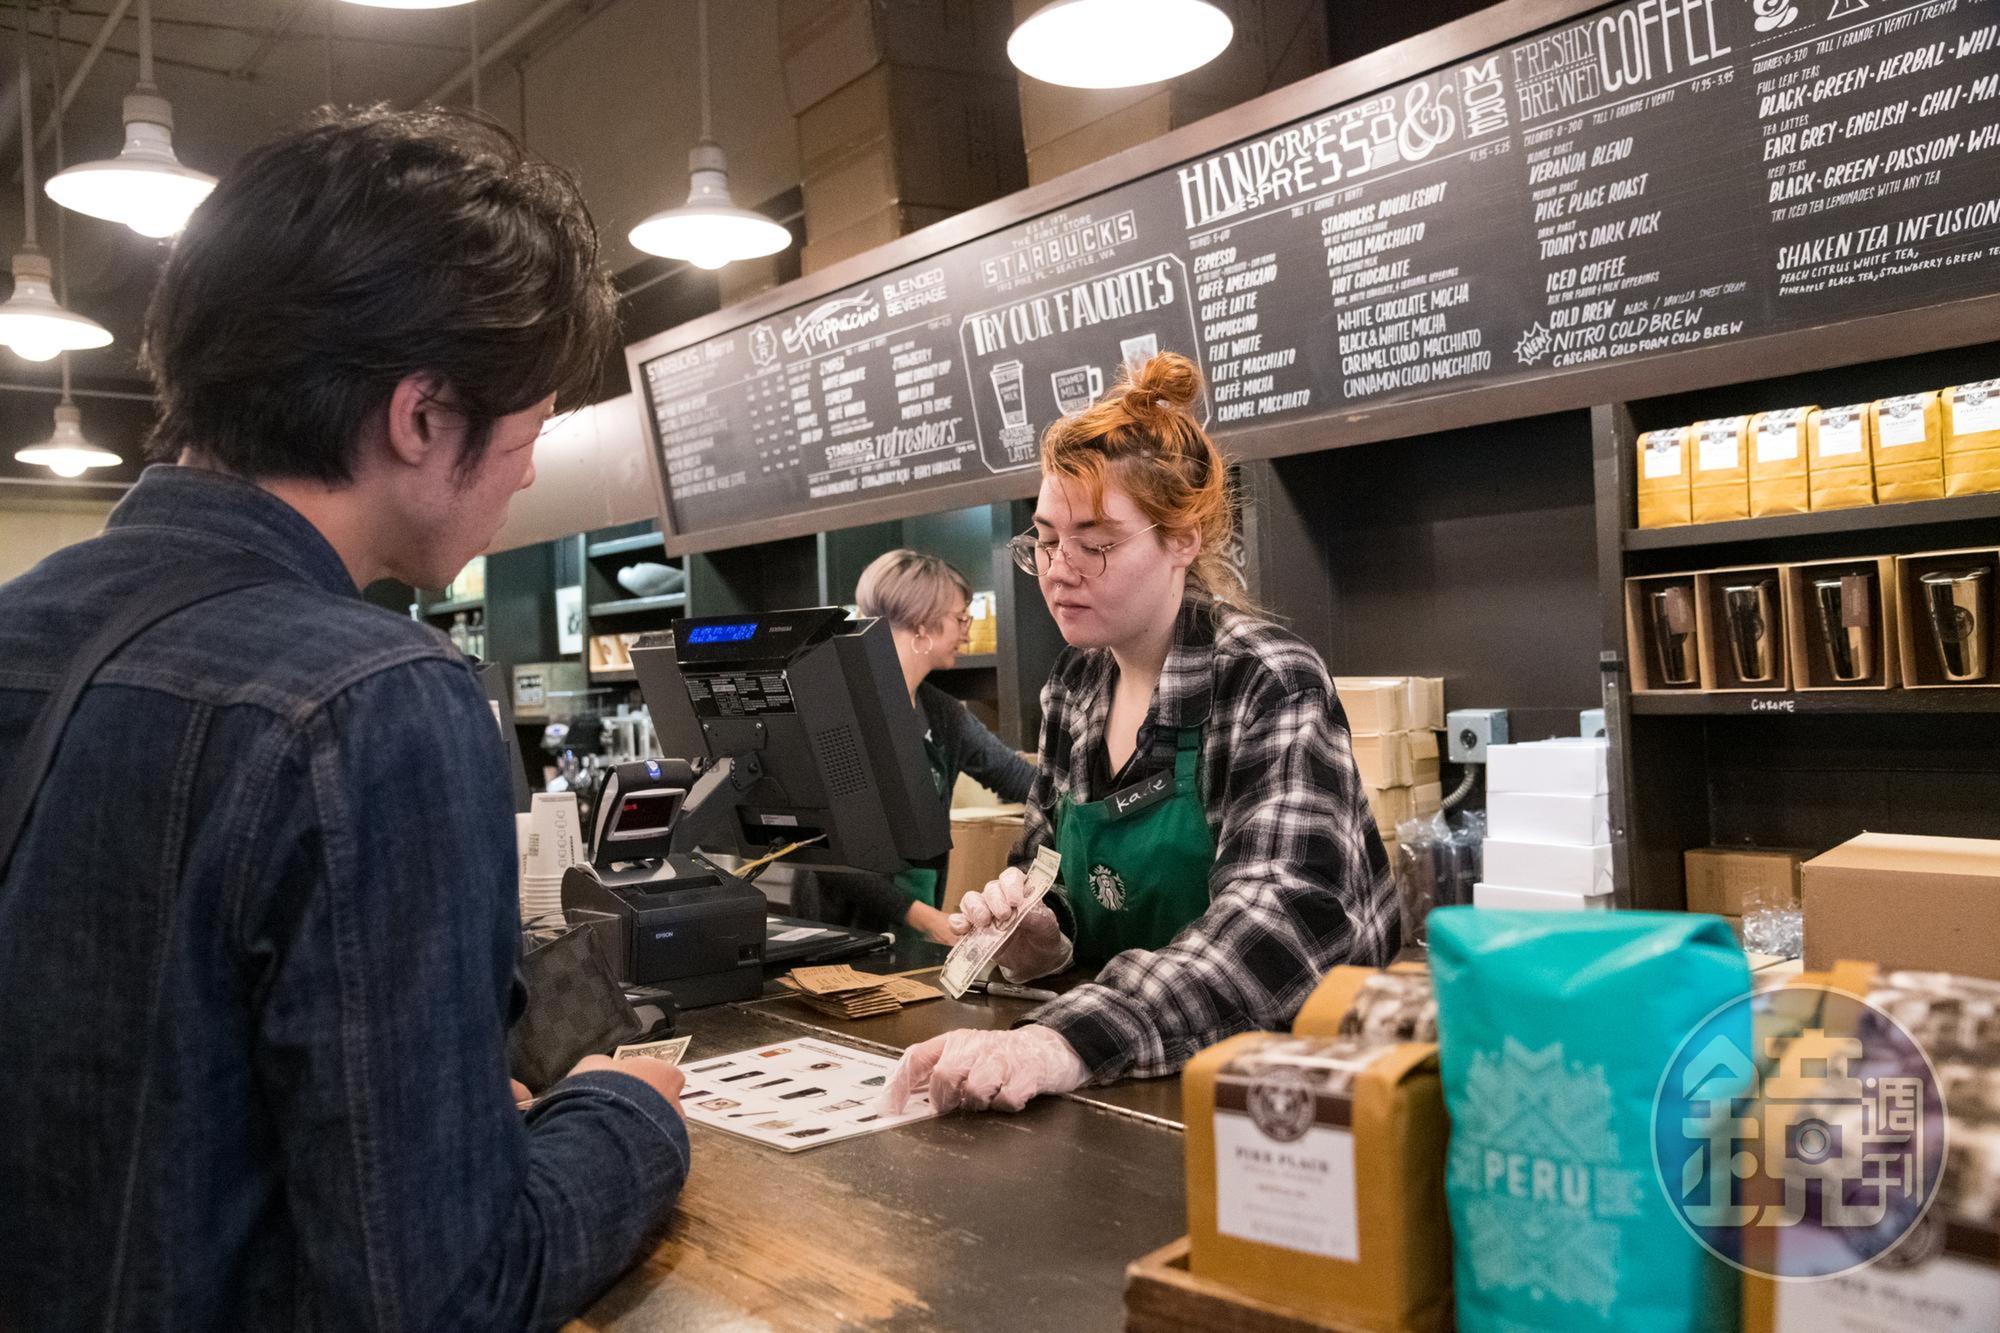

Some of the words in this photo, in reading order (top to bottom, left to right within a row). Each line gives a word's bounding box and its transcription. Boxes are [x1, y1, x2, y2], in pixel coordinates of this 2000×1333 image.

[1815, 38, 1834, 56] TALL
[1842, 24, 1876, 48] GRANDE
[1884, 13, 1913, 36] VENTI
[1919, 0, 1958, 23] TRENTA
[1512, 20, 1596, 84] FRESHLY
[1758, 84, 1808, 119] BLACK
[1812, 64, 1870, 103] GREEN
[1875, 41, 1945, 83] HERBAL
[1955, 24, 2000, 60] WHI
[1459, 55, 1510, 140] MORE
[1516, 62, 1602, 123] BREWED
[1756, 78, 1776, 96] FULL
[1778, 71, 1800, 89] LEAF
[1801, 64, 1821, 81] TEAS
[1592, 108, 1608, 126] TALL
[1615, 99, 1644, 119] GRANDE
[1651, 89, 1676, 108] VENTI
[1762, 121, 1779, 137] TEA
[1780, 113, 1810, 132] LATTES
[1763, 131, 1797, 163] EARL
[1800, 120, 1838, 152] GREY
[1845, 99, 1910, 140] ENGLISH
[1919, 83, 1964, 119] CHAI
[1177, 96, 1397, 230] HANDCRAFTED
[1197, 111, 1399, 227] ESPRESSO
[1528, 150, 1587, 185] VERANDA
[1591, 136, 1634, 168] BLEND
[1767, 162, 1788, 180] ICED
[1788, 158, 1808, 175] TEAS
[1768, 171, 1817, 203] BLACK
[1823, 153, 1881, 190] GREEN
[1884, 132, 1962, 174] PASSION
[1534, 196, 1566, 223] PIKE
[1568, 185, 1606, 214] PLACE
[1607, 172, 1649, 204] ROAST
[1558, 179, 1579, 194] ROAST
[1771, 208, 1788, 223] TRY
[1787, 203, 1808, 220] ICED
[1808, 199, 1825, 214] TEA
[1825, 185, 1876, 211] LEMONADES
[1876, 179, 1902, 199] WITH
[1902, 173, 1923, 192] ANY
[1923, 169, 1942, 186] TEA
[1012, 235, 1031, 249] THE
[1062, 213, 1091, 232] STORE
[1321, 203, 1376, 237] STARBUCKS
[1377, 181, 1448, 220] DOUBLESHOT
[1537, 225, 1556, 240] DARK
[1556, 219, 1577, 234] ROAST
[984, 214, 1134, 285] STARBUCKS
[1099, 248, 1116, 260] WA
[1327, 238, 1363, 267] MOCHA
[1363, 221, 1426, 257] MACCHIATO
[1539, 229, 1589, 260] TODAY'S
[1589, 220, 1625, 249] DARK
[1628, 210, 1662, 239] PICK
[1776, 231, 1853, 271] SHAKEN
[1856, 223, 1889, 254] TEA
[1895, 200, 2000, 246] INFUSION
[1194, 247, 1237, 274] ESPRESSO
[1226, 263, 1278, 294] AMERICANO
[1331, 274, 1354, 296] HOT
[1354, 258, 1411, 290] CHOCOLATE
[1545, 267, 1578, 293] ICED
[1579, 255, 1628, 286] COFFEE
[1778, 281, 1826, 297] PINEAPPLE
[1827, 275, 1856, 288] BLACK
[1857, 270, 1879, 282] TEA,
[1879, 256, 1944, 279] STRAWBERRY
[1945, 250, 1983, 266] GREEN
[1988, 246, 2000, 256] TE
[1779, 269, 1810, 285] PEACH
[1811, 261, 1851, 279] CITRUS
[1853, 251, 1892, 270] WHITE
[1895, 247, 1919, 261] TEA,
[883, 267, 945, 301] BLENDED
[1229, 291, 1258, 315] LATTE
[1549, 304, 1580, 330] COLD
[1581, 298, 1617, 324] BREW
[1623, 299, 1649, 316] BLACK
[1662, 290, 1696, 308] VANILLA
[1722, 281, 1747, 295] CREAM
[1561, 290, 1574, 303] FOR
[1602, 279, 1621, 294] MILK
[966, 311, 1007, 357] TRY
[1009, 298, 1052, 345] OUR
[1053, 261, 1175, 334] FAVORITES
[1204, 313, 1259, 342] CAPPUCCINO
[1337, 306, 1373, 332] WHITE
[1375, 292, 1428, 323] CHOCOLATE
[1430, 283, 1470, 310] MOCHA
[1553, 324, 1607, 353] NITRO
[1608, 317, 1649, 342] COLD
[1649, 306, 1704, 334] BREW
[1209, 341, 1229, 362] FLAT
[1231, 334, 1262, 358] WHITE
[1339, 329, 1369, 355] BLACK
[1378, 321, 1410, 346] WHITE
[1411, 313, 1447, 339] MOCHA
[1341, 346, 1390, 376] CARAMEL
[1389, 341, 1420, 366] CLOUD
[1423, 328, 1482, 359] MACCHIATO
[1552, 345, 1608, 368] CASCARA
[1609, 341, 1639, 361] COLD
[1638, 334, 1670, 355] FOAM
[1671, 330, 1701, 346] COLD
[1703, 319, 1744, 340] BREW
[1212, 360, 1240, 383] LATTE
[1242, 347, 1297, 377] MACCHIATO
[1242, 374, 1274, 398] MOCHA
[1343, 369, 1401, 399] CINNAMON
[1401, 364, 1431, 387] CLOUD
[1432, 350, 1492, 382] MACCHIATO
[1060, 384, 1085, 399] MILK
[1217, 399, 1256, 423] CARAMEL
[1257, 389, 1311, 416] MACCHIATO
[1007, 443, 1036, 463] LATTE
[1750, 698, 1796, 713] CHROME
[1277, 1153, 1329, 1174] PLACE
[1483, 1149, 1590, 1210] PERU
